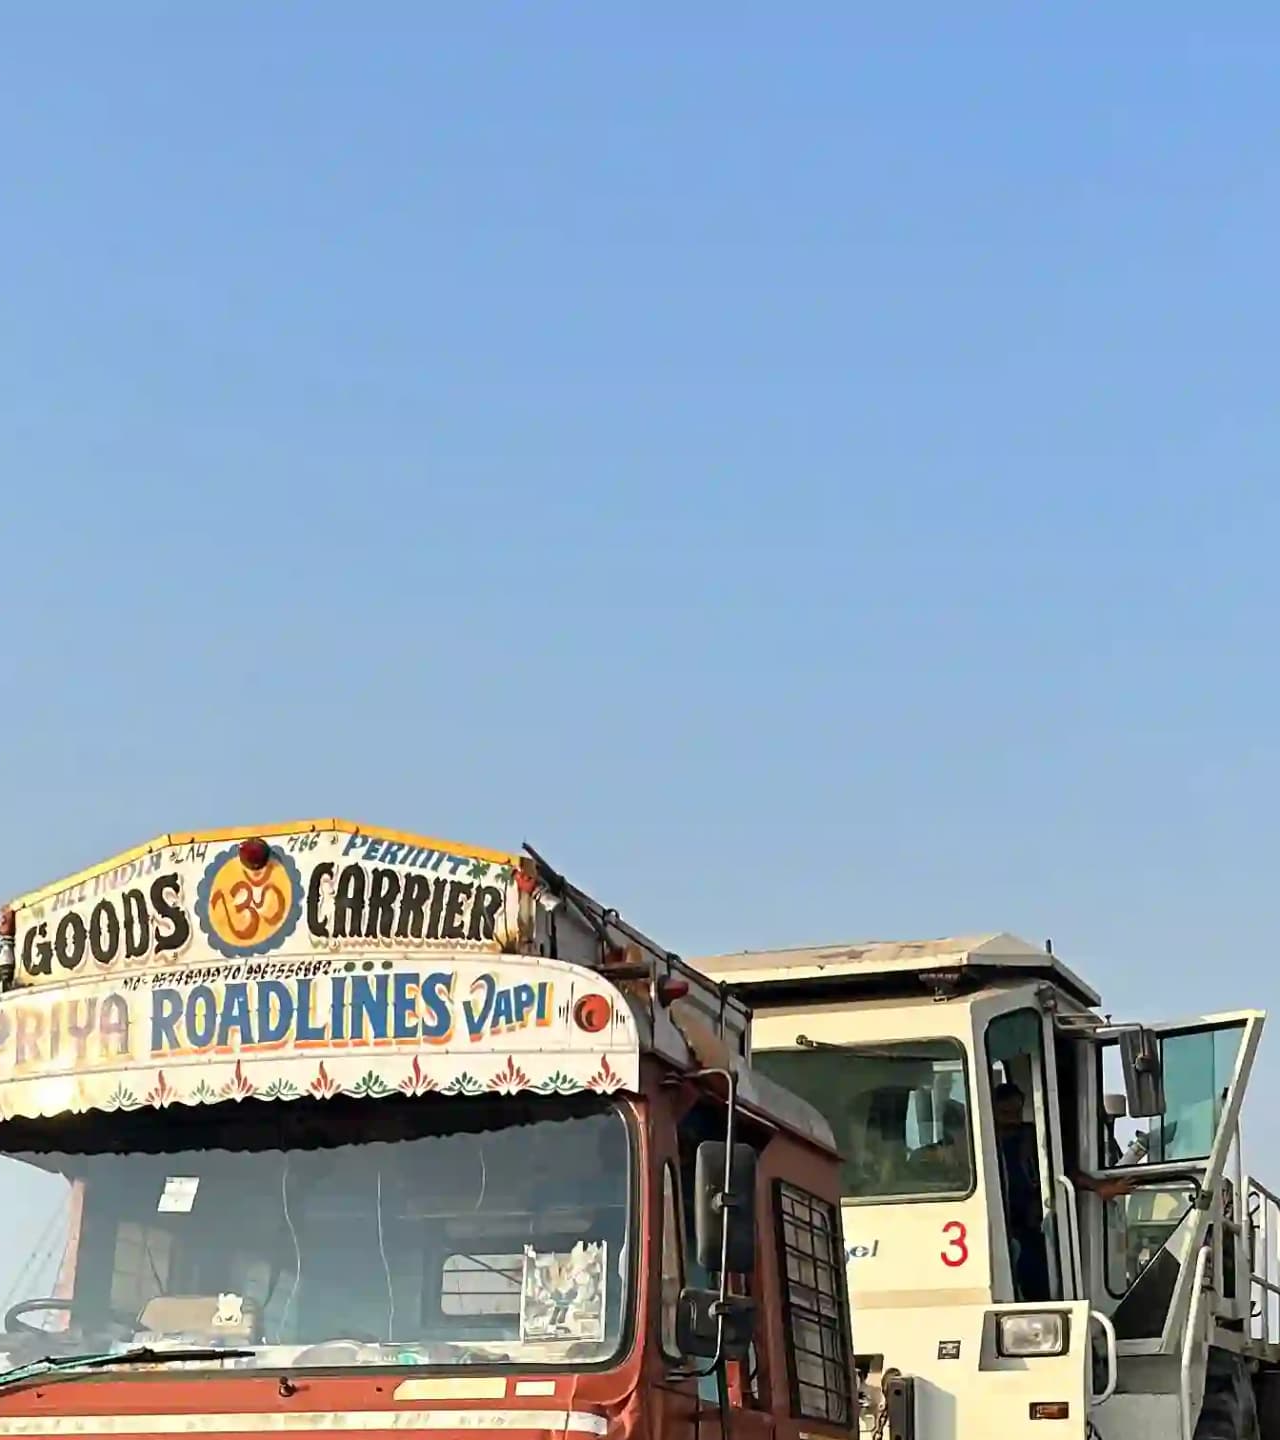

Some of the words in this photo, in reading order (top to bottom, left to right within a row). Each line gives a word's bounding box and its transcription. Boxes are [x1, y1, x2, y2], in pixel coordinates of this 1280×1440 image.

[93, 852, 162, 896] INDIA
[342, 833, 470, 875] PERMIT
[287, 833, 321, 852] 786
[21, 872, 191, 977] GOODS
[306, 861, 503, 942] CARRIER
[150, 971, 454, 1052] ROADLINES
[463, 974, 549, 1034] VAPI
[940, 1220, 969, 1268] 3
